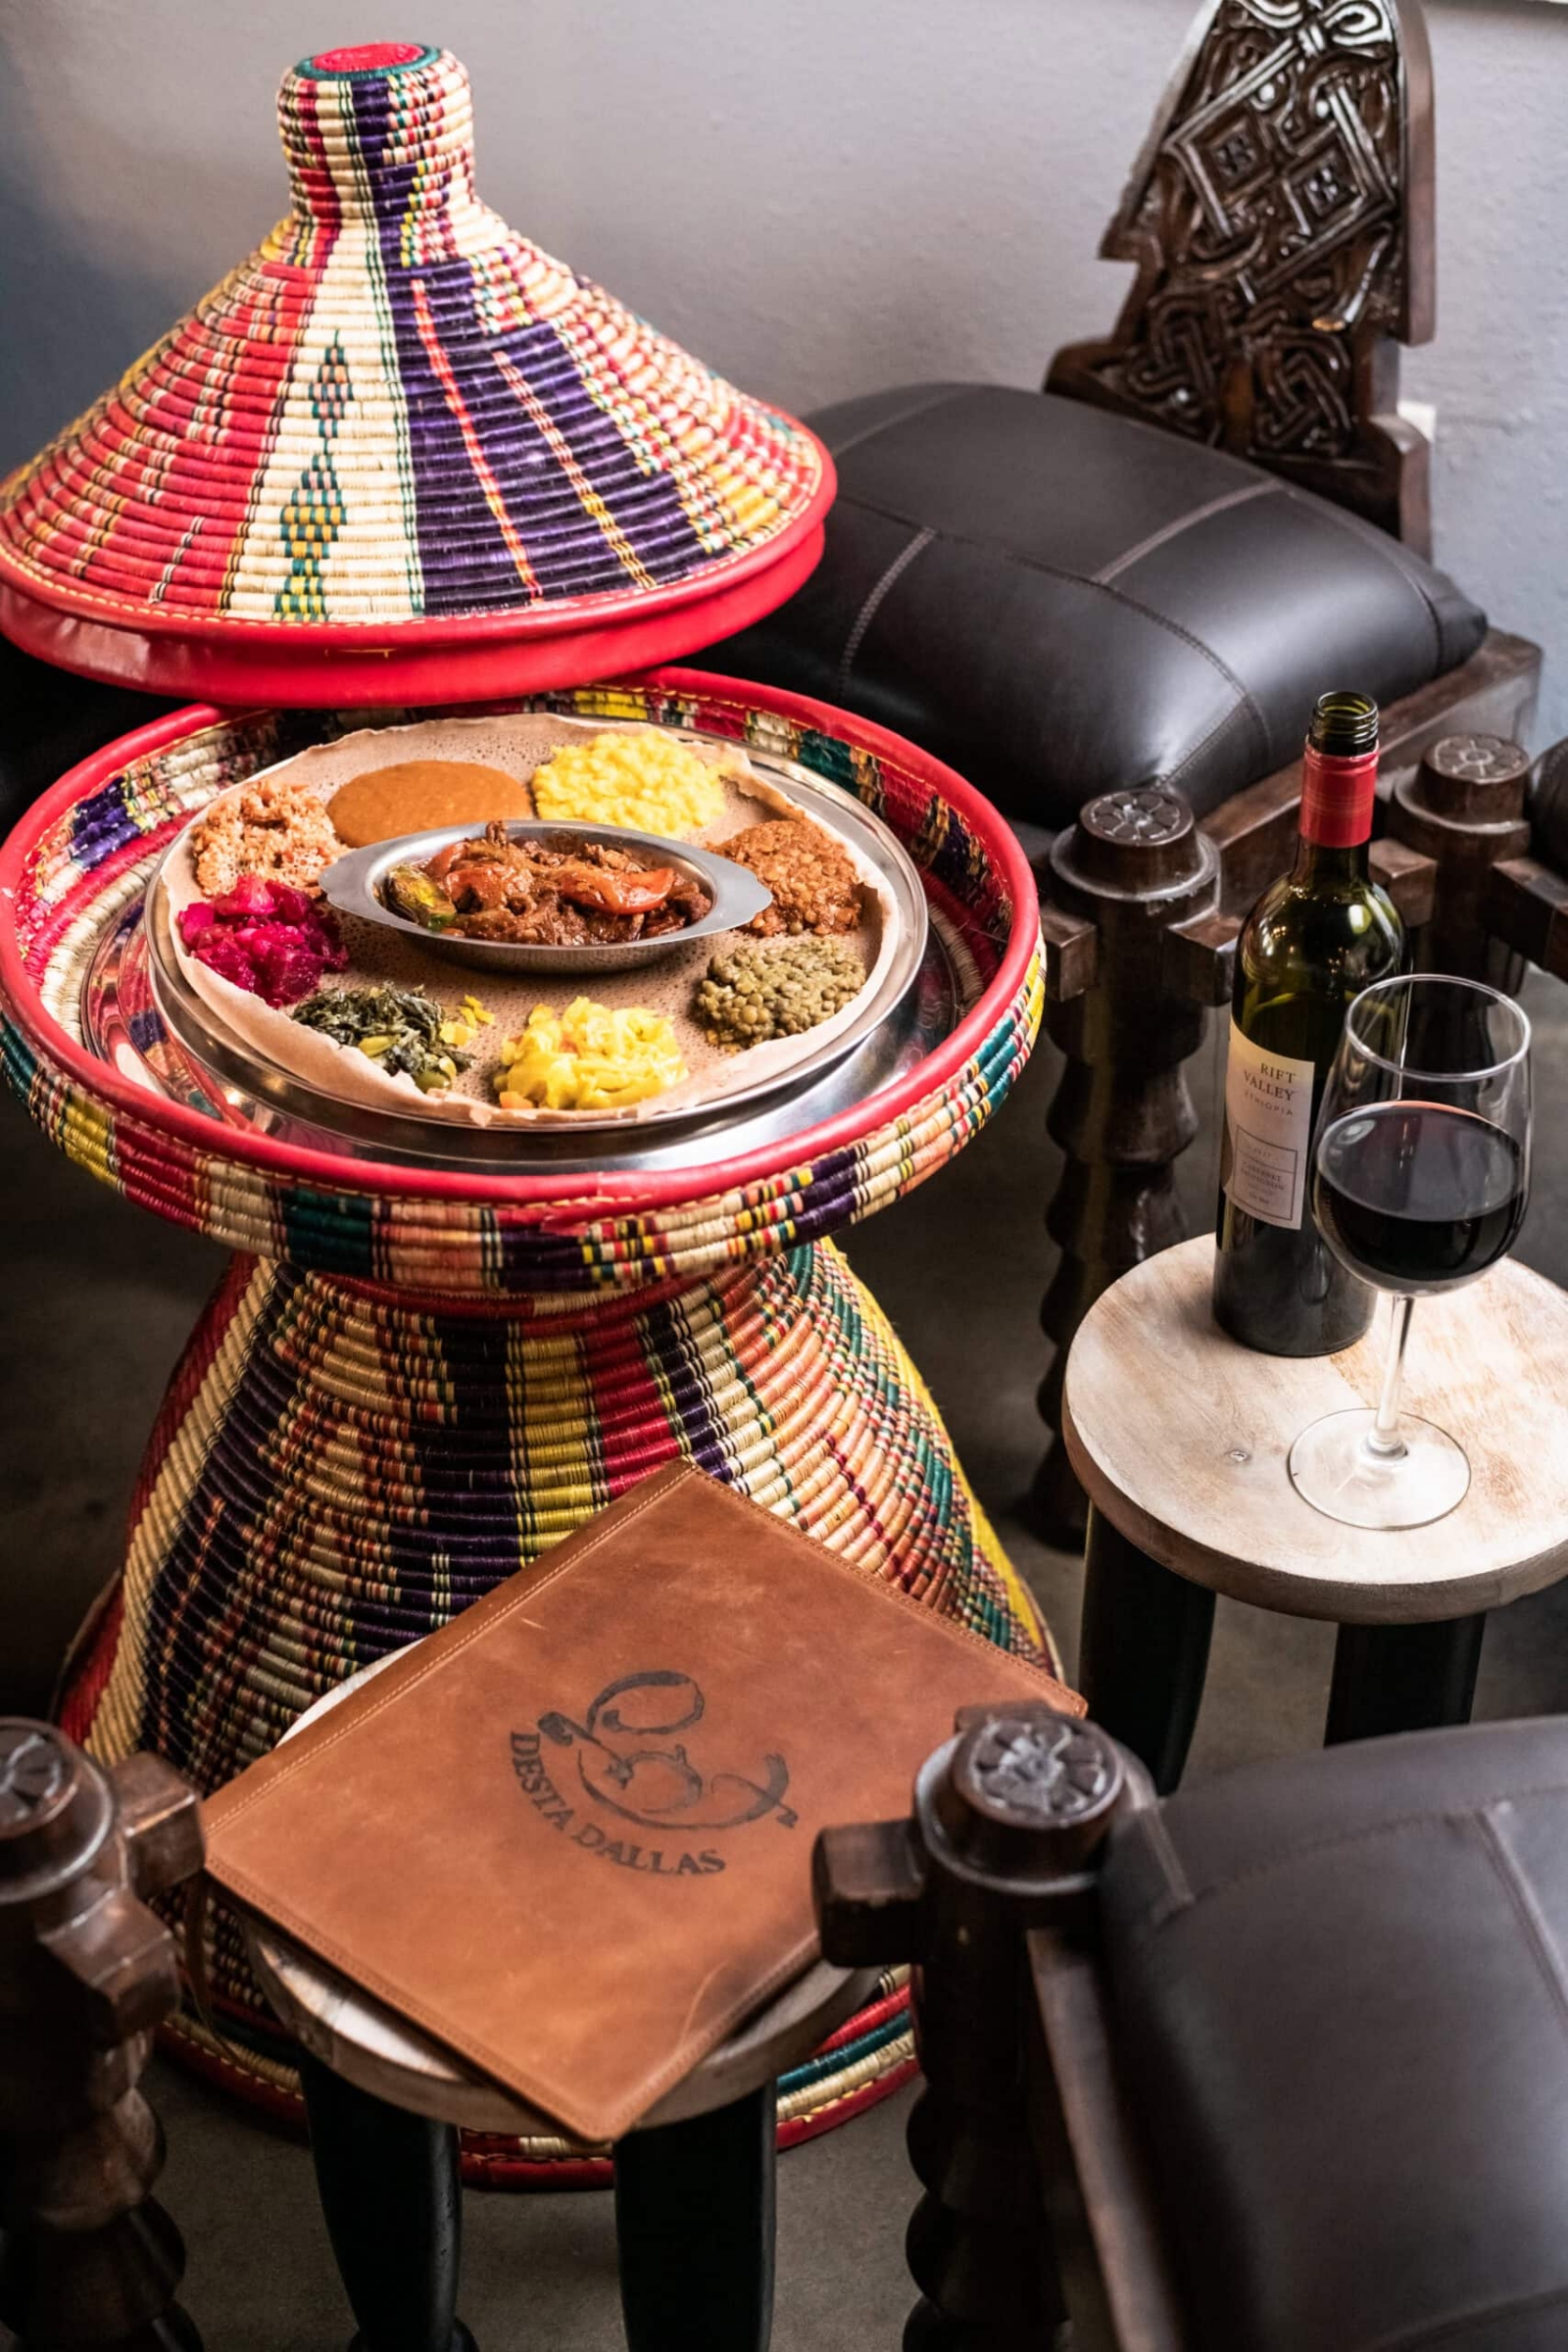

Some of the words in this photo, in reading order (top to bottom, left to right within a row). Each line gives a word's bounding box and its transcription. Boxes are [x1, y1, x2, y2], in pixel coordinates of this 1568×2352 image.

[1244, 1069, 1295, 1101] VALLEY
[1260, 1062, 1296, 1084] RIFT
[1245, 1090, 1294, 1116] ETHIOPIA
[511, 1731, 574, 1831] DESTA
[571, 1823, 726, 1875] DALLAS
